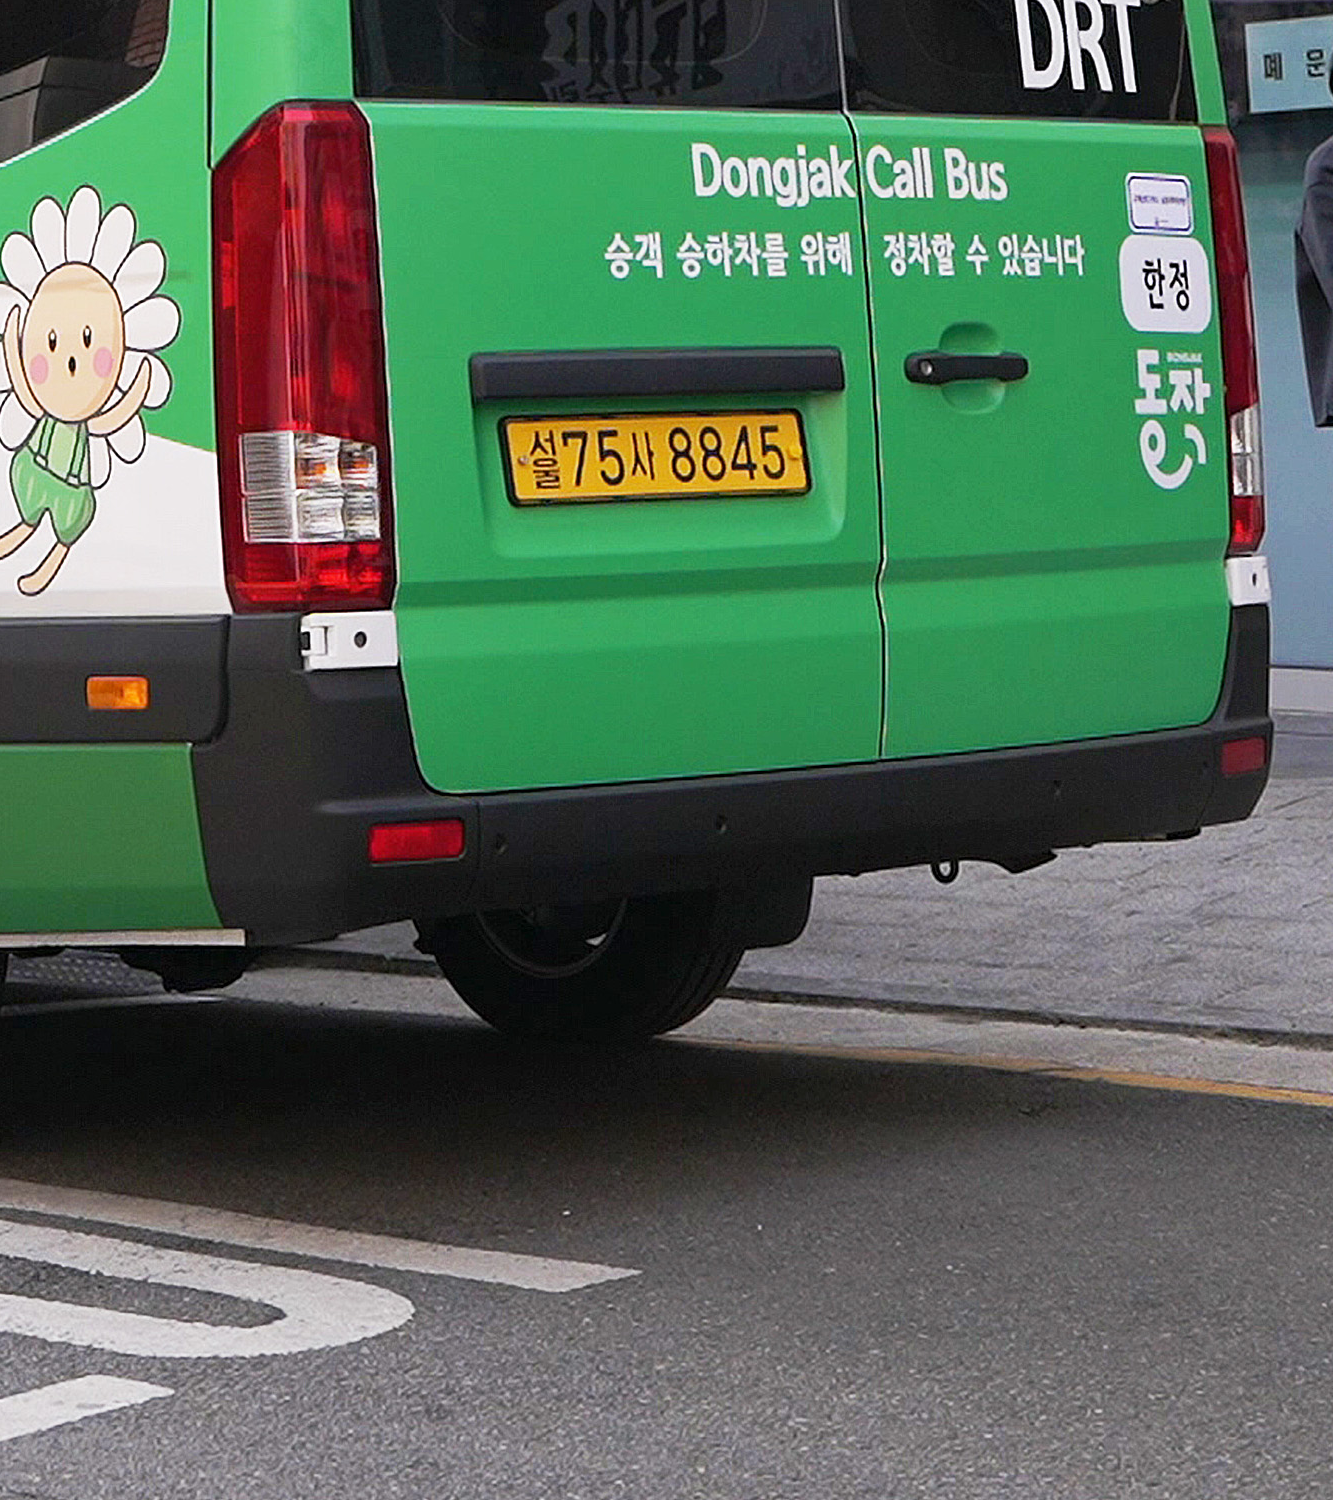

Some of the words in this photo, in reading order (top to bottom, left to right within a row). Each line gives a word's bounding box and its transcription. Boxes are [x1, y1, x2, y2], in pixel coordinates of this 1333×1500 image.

[690, 142, 857, 207] Dongjak
[865, 144, 933, 198] Call
[944, 147, 1009, 201] Bus
[604, 232, 663, 279] 승객
[676, 231, 788, 278] 승하차를
[799, 231, 854, 277] 위해
[883, 233, 956, 277] 정차할
[964, 233, 990, 276] 수
[998, 234, 1086, 277] 있습니다
[1142, 257, 1191, 312] 한정
[667, 424, 786, 483] 8845
